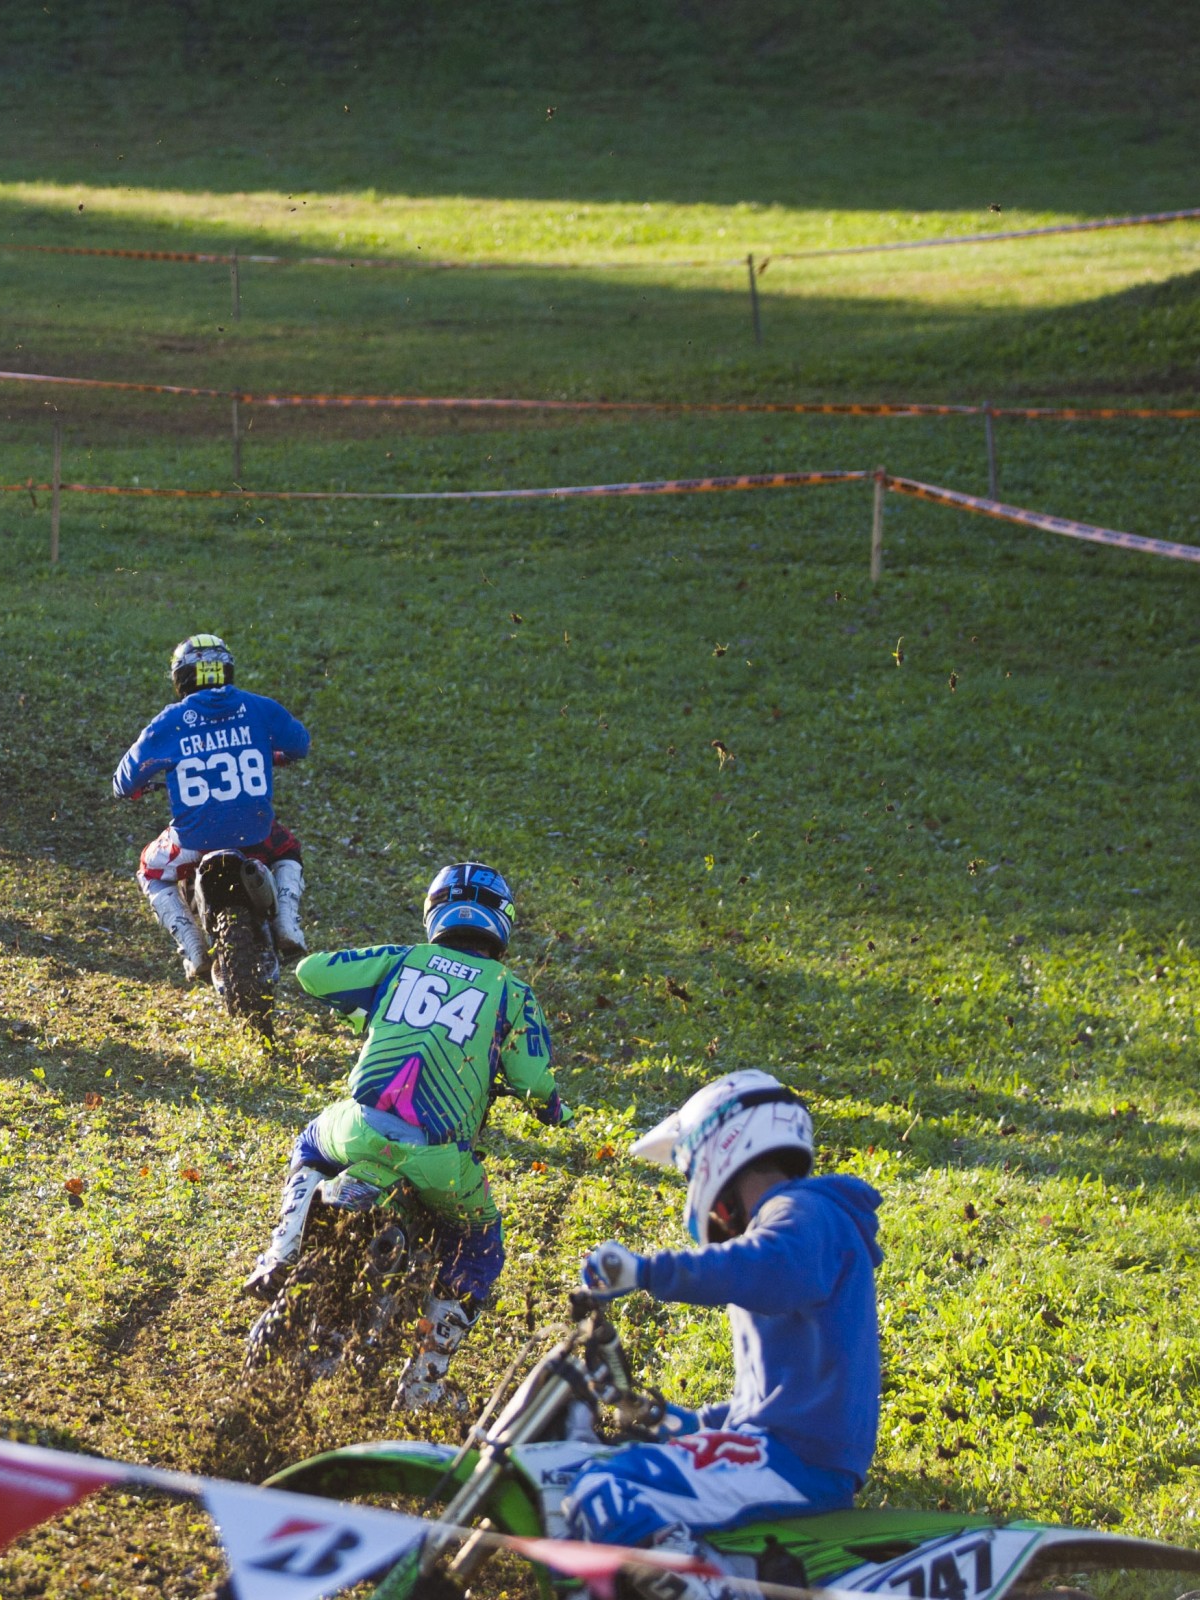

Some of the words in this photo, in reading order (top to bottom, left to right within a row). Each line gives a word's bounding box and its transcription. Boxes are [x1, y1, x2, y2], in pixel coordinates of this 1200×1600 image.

[180, 726, 252, 756] GRAHAM
[176, 749, 267, 807] 638
[427, 954, 483, 983] FREET
[383, 965, 489, 1047] 164
[889, 1538, 993, 1600] 747
